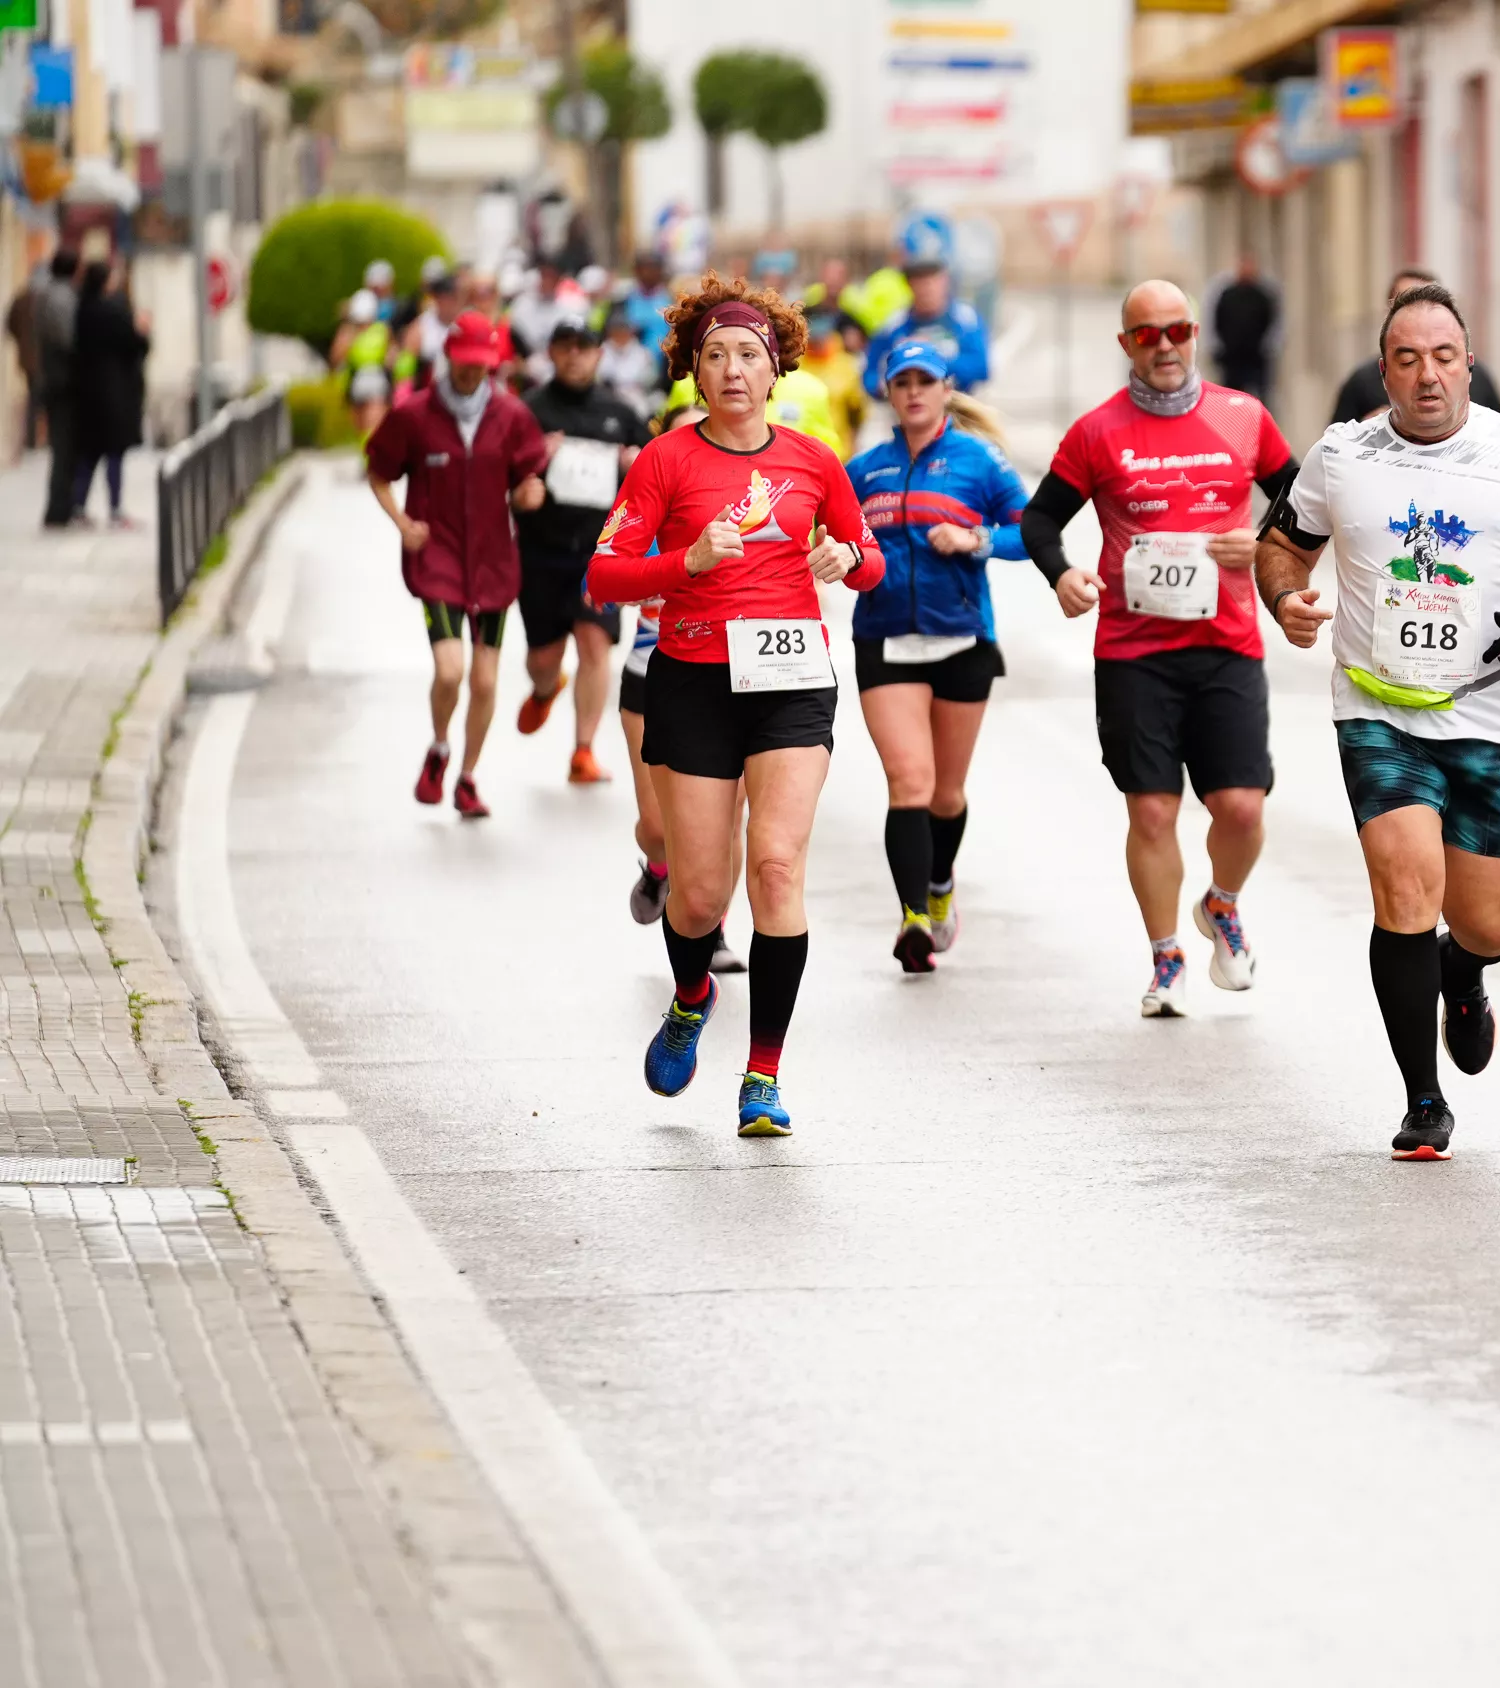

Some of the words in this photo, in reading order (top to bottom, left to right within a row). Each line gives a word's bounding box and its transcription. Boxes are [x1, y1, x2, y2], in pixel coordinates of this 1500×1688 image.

[1149, 564, 1198, 587] 207
[1417, 602, 1452, 614] LUCENA
[756, 628, 806, 656] 283
[1400, 620, 1458, 651] 618
